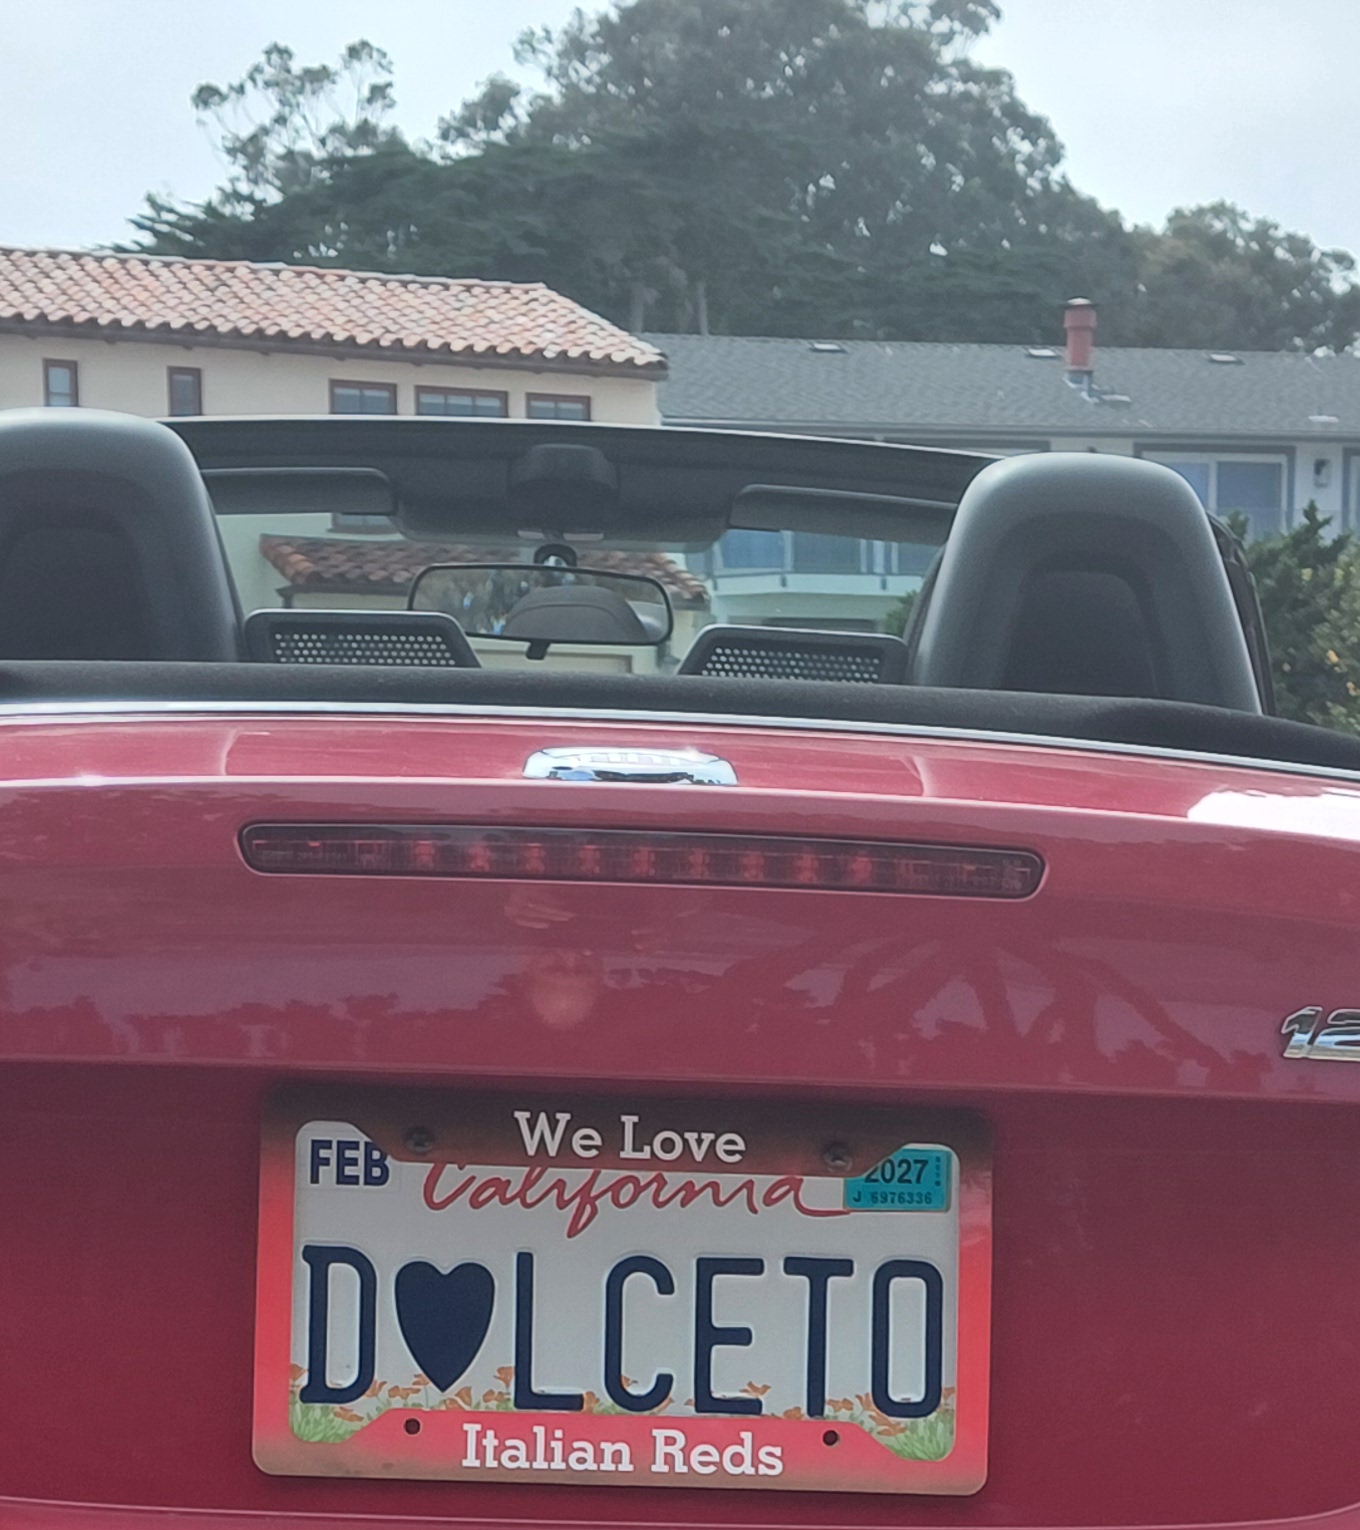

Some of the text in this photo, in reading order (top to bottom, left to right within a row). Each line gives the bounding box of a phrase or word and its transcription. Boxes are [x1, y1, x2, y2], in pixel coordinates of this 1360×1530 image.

[309, 1138, 390, 1187] FEB
[513, 1110, 747, 1164] We Love
[422, 1163, 852, 1239] California
[461, 1422, 784, 1476] Italian Reds
